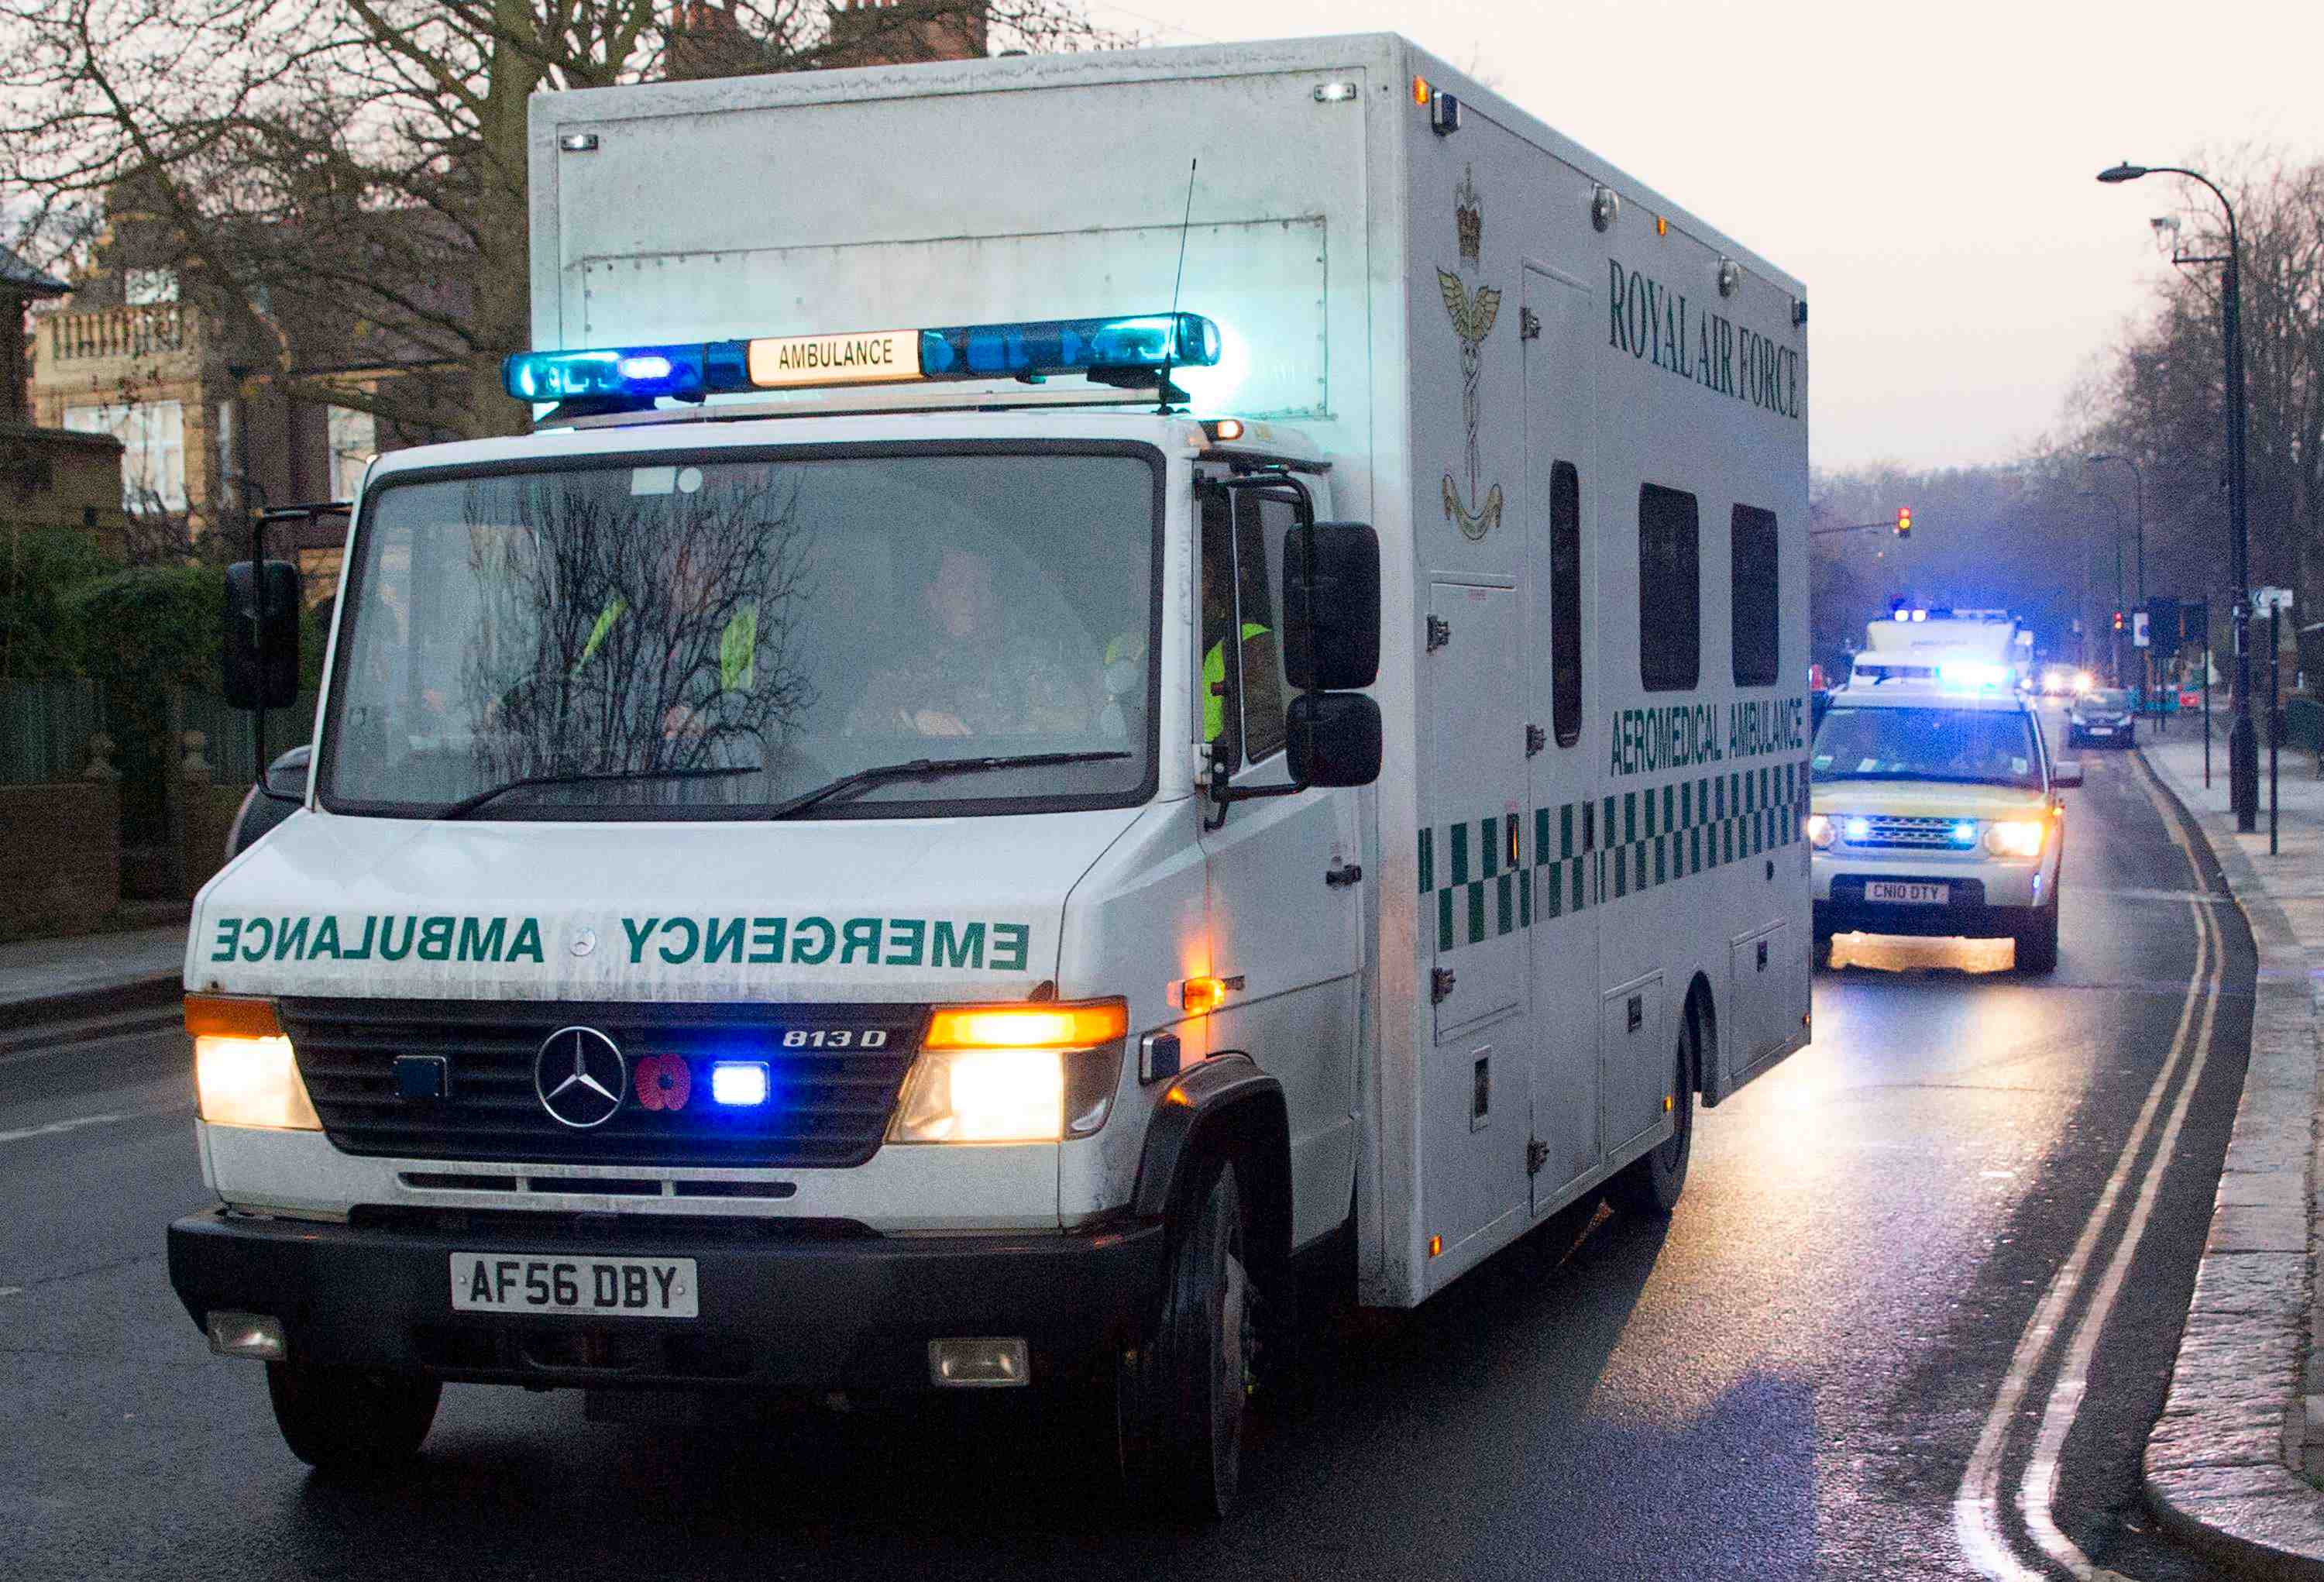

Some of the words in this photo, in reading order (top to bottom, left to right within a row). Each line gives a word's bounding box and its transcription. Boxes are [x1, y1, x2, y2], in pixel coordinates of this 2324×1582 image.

[779, 339, 893, 370] AMBULANCE
[1609, 258, 1693, 378] ROYAL
[1697, 310, 1736, 397] AIR
[1739, 327, 1799, 418] FORCE
[1611, 703, 1722, 777] AEROMEDICAL
[1729, 698, 1803, 758] AMBULANCE
[1910, 885, 1939, 899] DTY
[782, 1030, 851, 1047] 813
[860, 1030, 887, 1047] D
[469, 1260, 578, 1306] AF56
[592, 1264, 677, 1309] DBY
